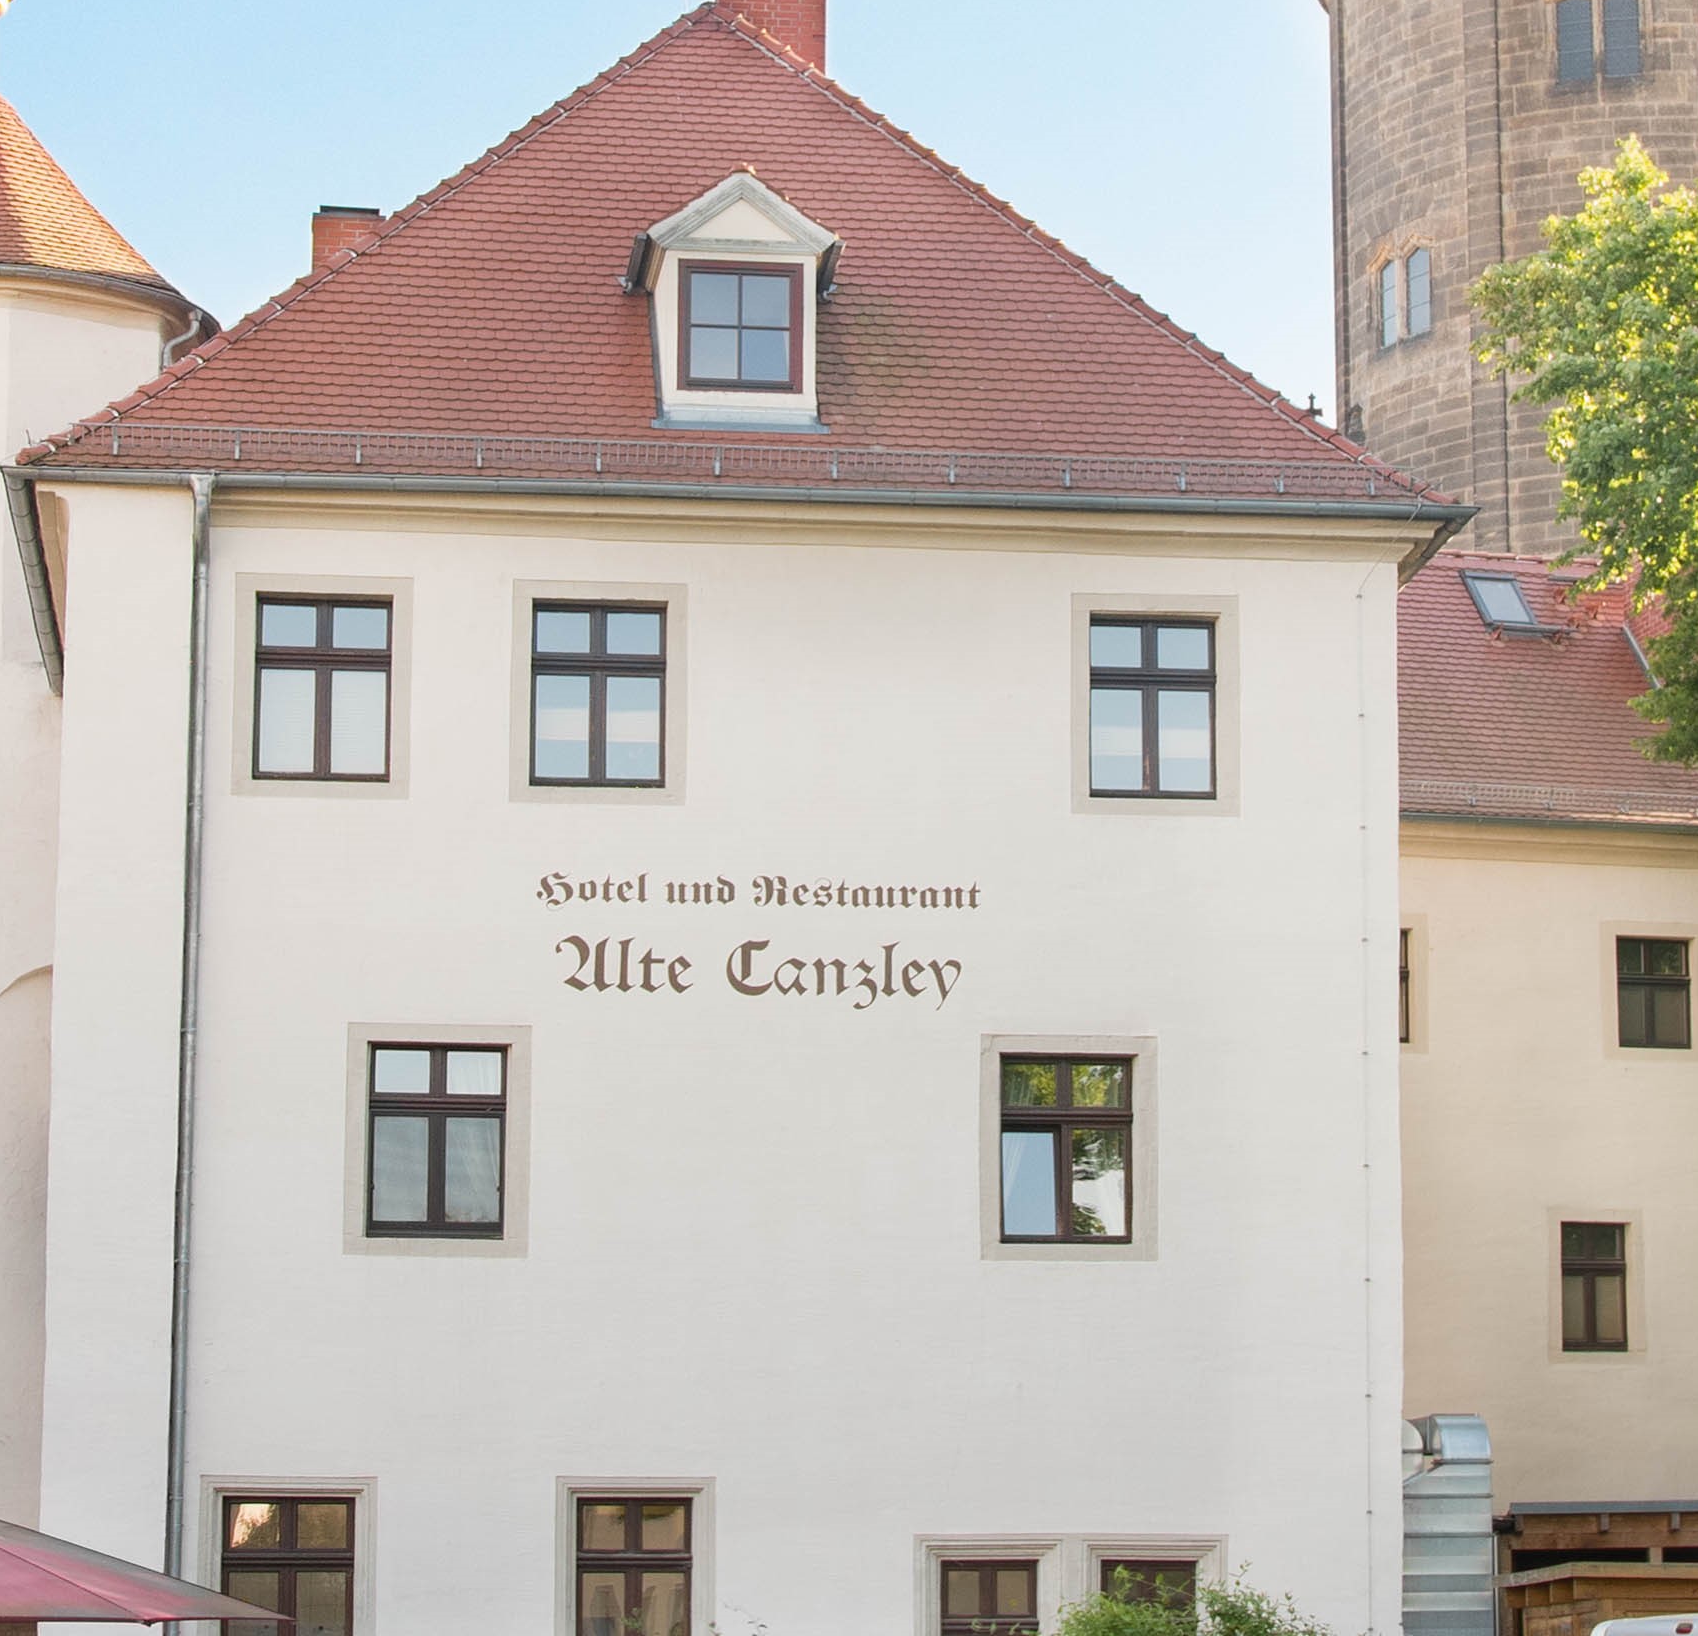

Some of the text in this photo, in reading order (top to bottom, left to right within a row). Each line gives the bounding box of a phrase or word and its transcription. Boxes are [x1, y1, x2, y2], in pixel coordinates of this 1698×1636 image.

[535, 871, 982, 910] Hotel und Restaurant
[555, 934, 962, 1011] Alte Canzley
